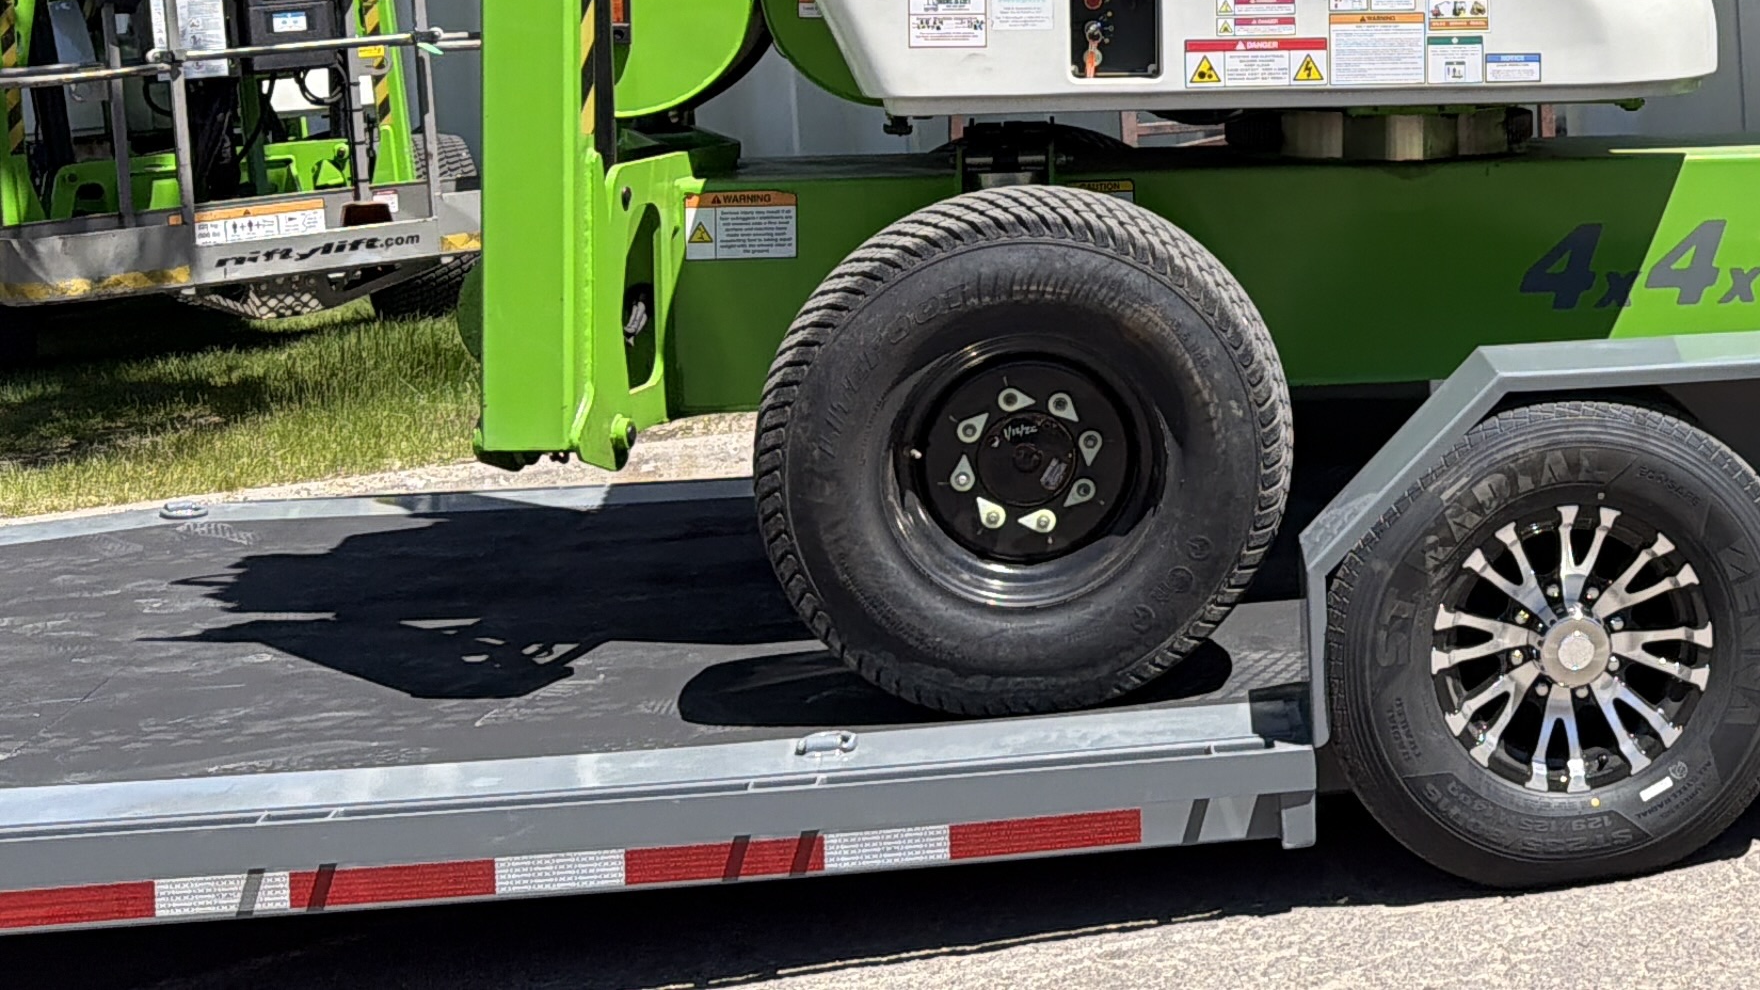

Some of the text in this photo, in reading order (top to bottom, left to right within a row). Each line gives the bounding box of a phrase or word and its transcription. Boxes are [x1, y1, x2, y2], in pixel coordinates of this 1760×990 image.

[1246, 41, 1279, 49] DANGER
[723, 194, 771, 203] WARNING
[214, 233, 420, 268] niftylift.com
[1420, 450, 1610, 571] RADIAL
